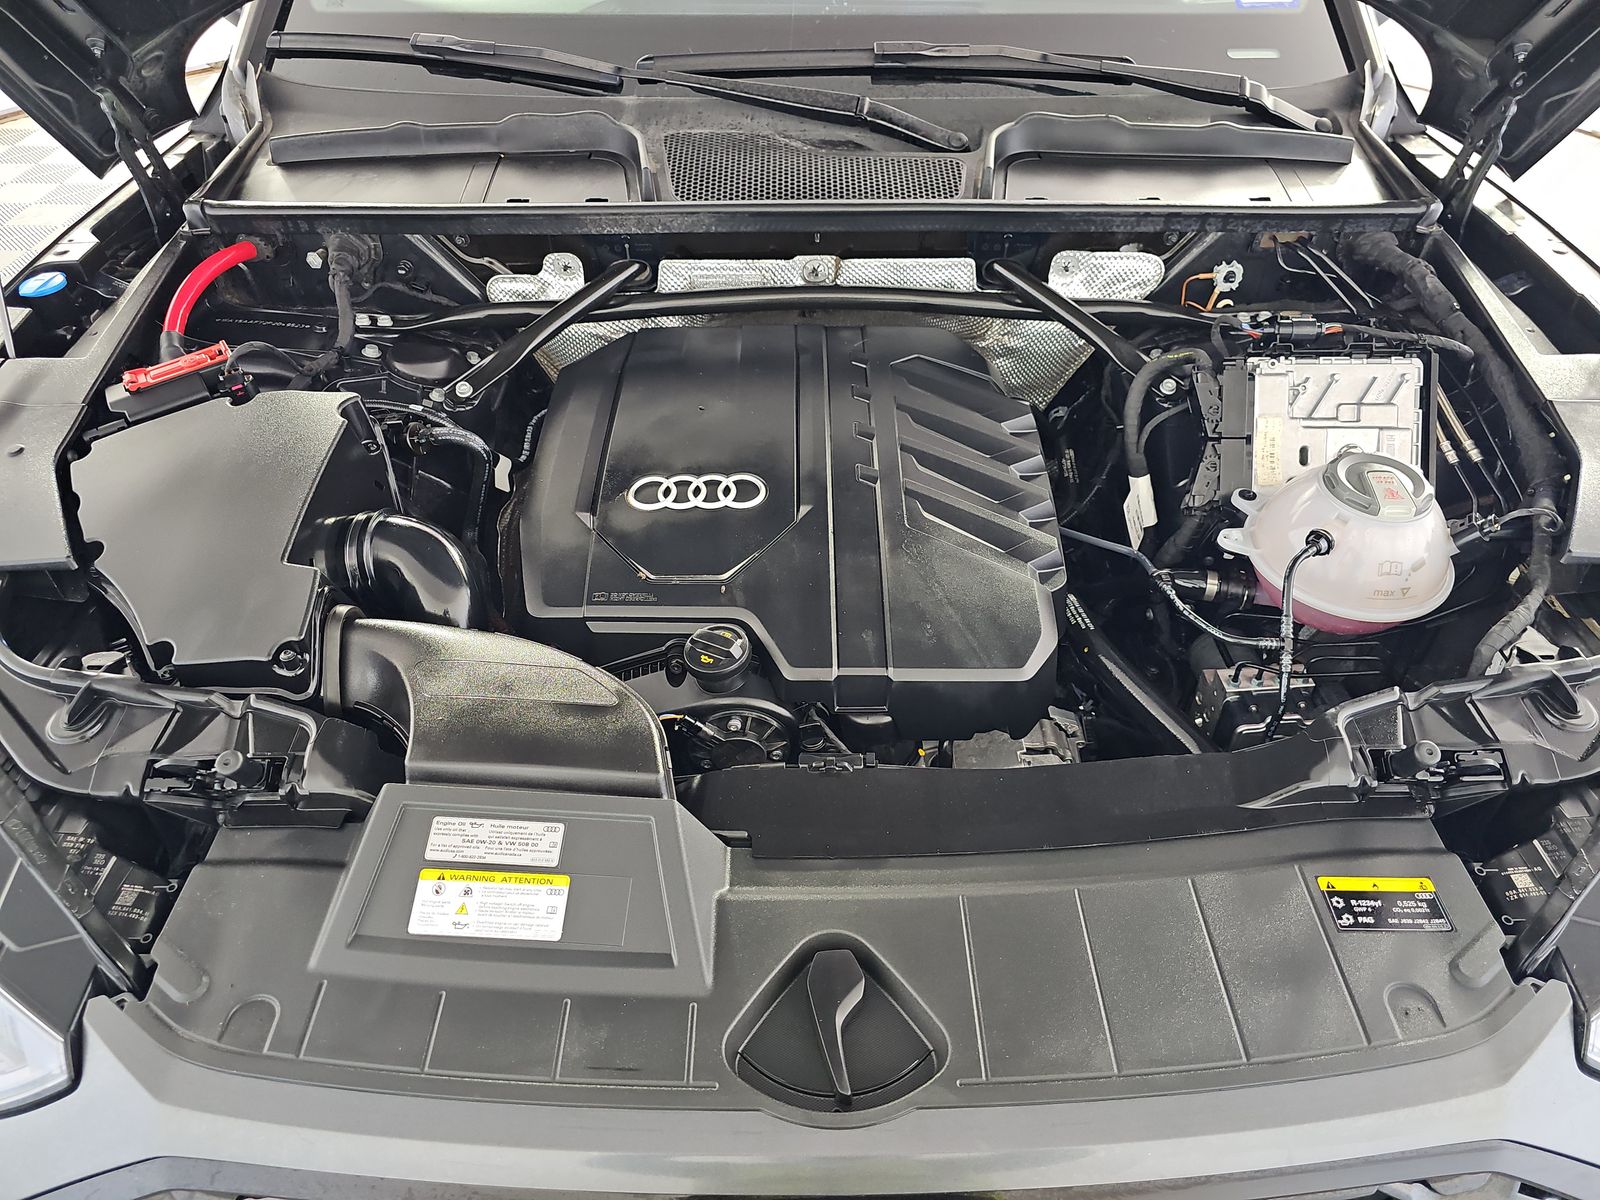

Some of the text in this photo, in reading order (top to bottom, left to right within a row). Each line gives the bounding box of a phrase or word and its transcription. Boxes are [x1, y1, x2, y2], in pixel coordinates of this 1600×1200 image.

[1373, 589, 1396, 597] max
[450, 874, 554, 885] WARNING ATTENTION
